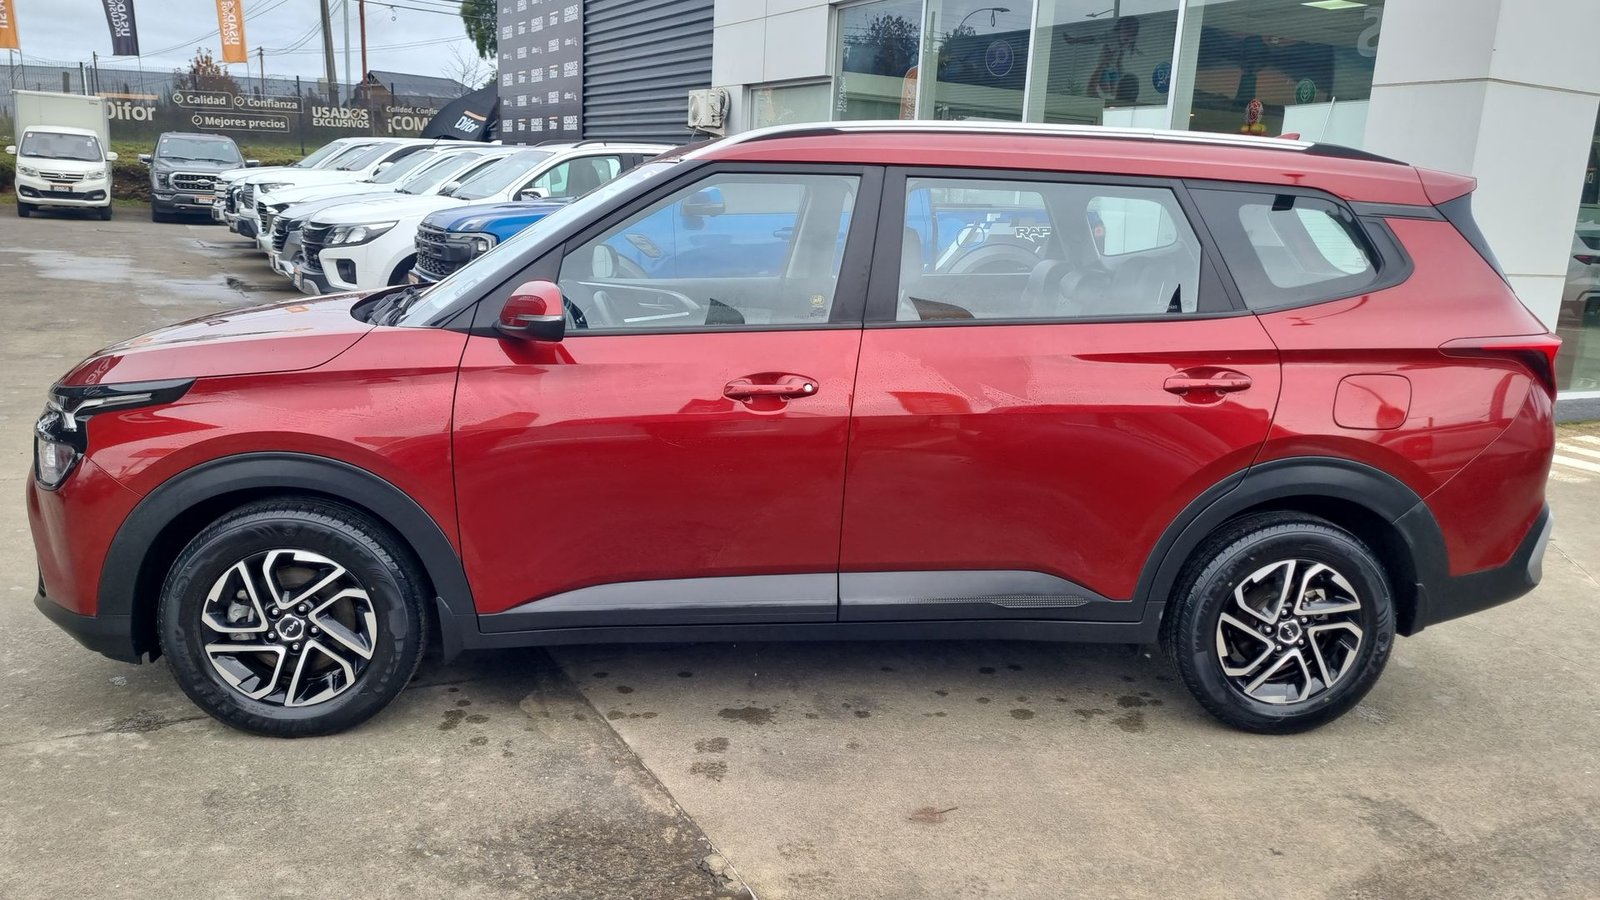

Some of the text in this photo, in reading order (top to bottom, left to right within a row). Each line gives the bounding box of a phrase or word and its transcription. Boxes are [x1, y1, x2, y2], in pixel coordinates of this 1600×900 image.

[187, 95, 226, 105] Calidad
[247, 98, 298, 109] Confianza
[107, 101, 156, 121] Difor
[312, 106, 369, 120] USADOS
[205, 116, 286, 129] Mejores precios
[312, 117, 370, 129] EXCLUSIVOS
[387, 115, 433, 133] ¡COM
[454, 115, 480, 133] Difor
[1015, 227, 1051, 242] RAP
